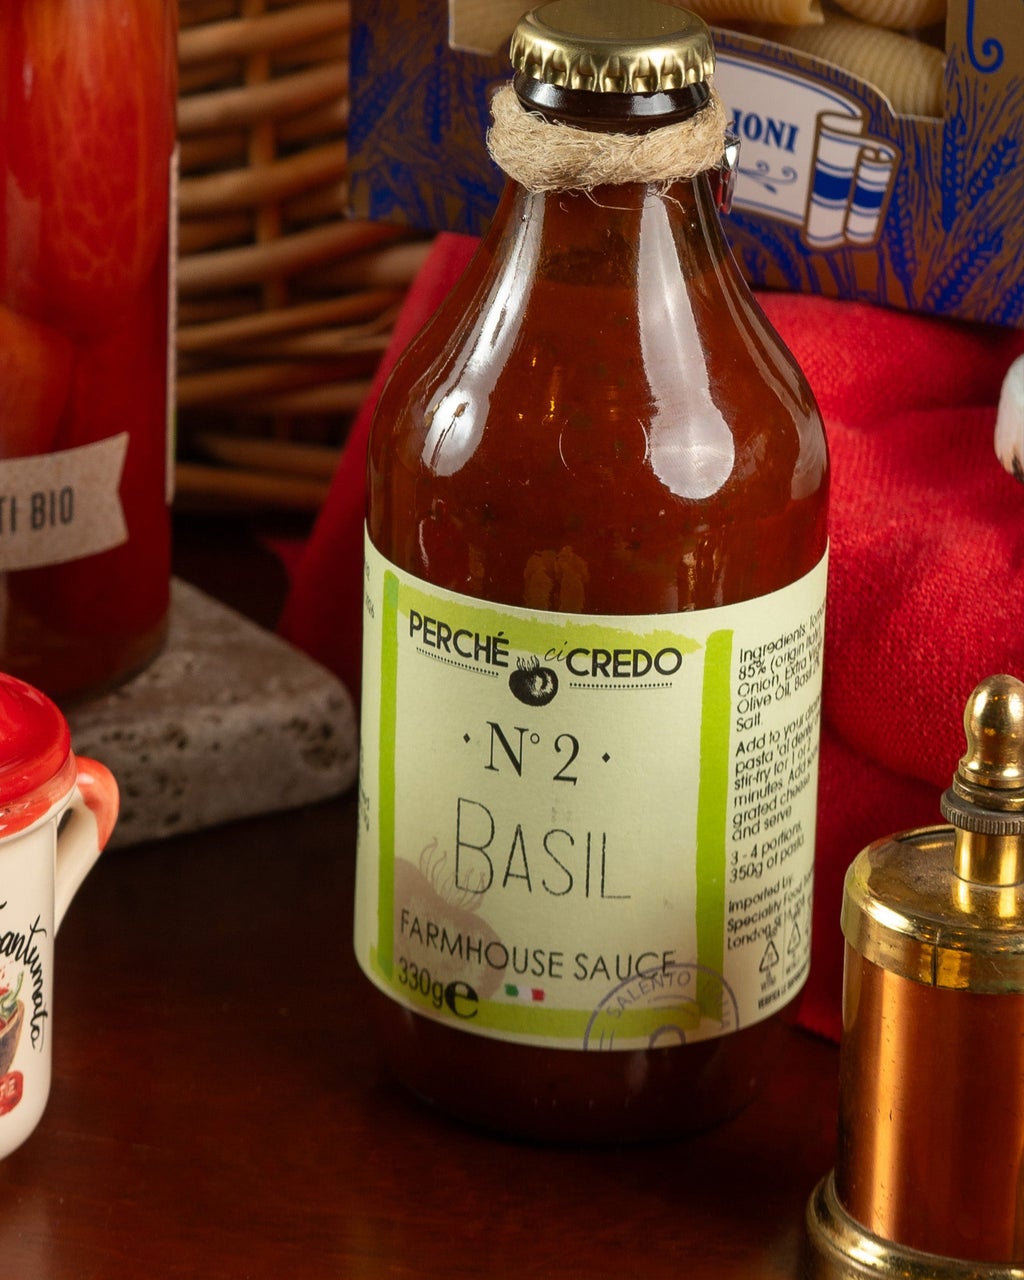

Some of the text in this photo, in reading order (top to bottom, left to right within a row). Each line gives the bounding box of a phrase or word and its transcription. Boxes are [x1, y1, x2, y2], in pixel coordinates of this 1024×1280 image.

[30, 485, 75, 532] BIO
[410, 609, 510, 668] PERCHÉ
[566, 646, 684, 679] CREDO
[738, 659, 766, 681] 85%
[737, 694, 772, 715] Olive
[735, 733, 766, 757] Add
[769, 729, 780, 744] to
[553, 733, 580, 787] 2
[735, 751, 773, 777] pasta
[734, 766, 771, 791] stir-fry
[732, 795, 777, 829] grated
[732, 820, 760, 842] and
[729, 861, 763, 884] 350g
[766, 851, 778, 869] of
[750, 843, 758, 859] 4
[728, 880, 780, 913] Imported
[400, 908, 677, 982] FARMHOUSE SAUCE
[605, 970, 692, 1020] SALENTO
